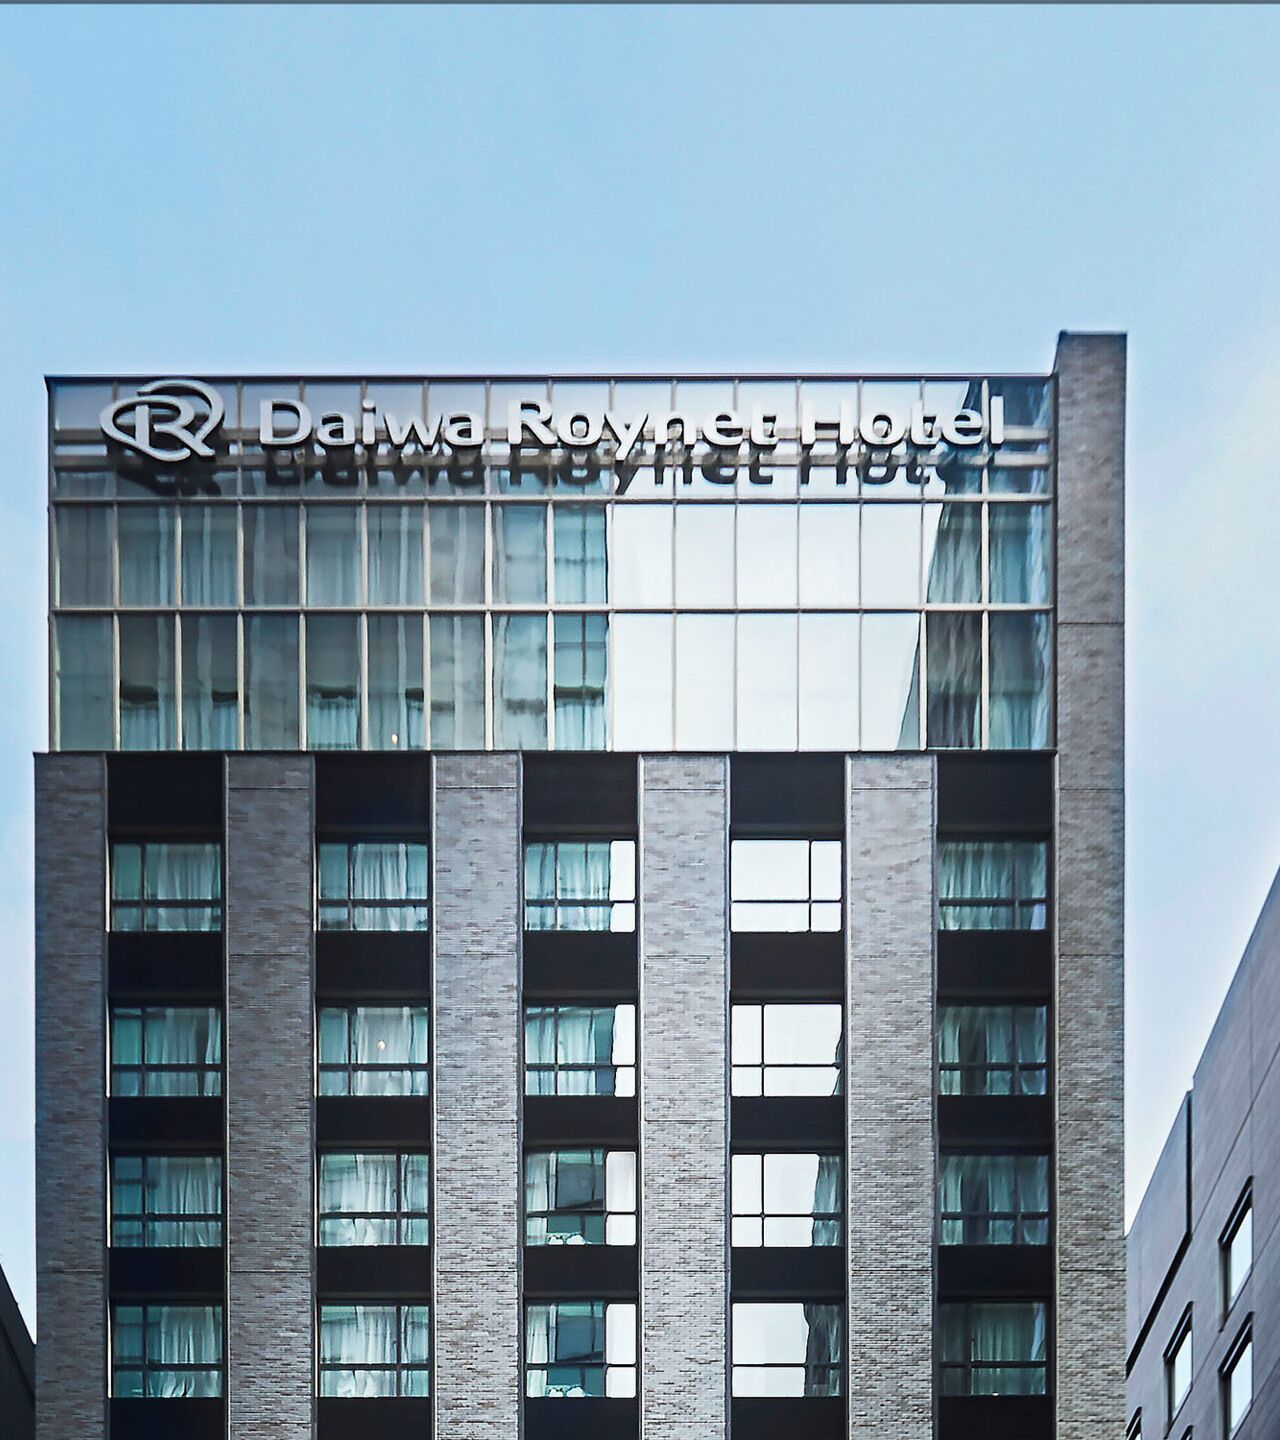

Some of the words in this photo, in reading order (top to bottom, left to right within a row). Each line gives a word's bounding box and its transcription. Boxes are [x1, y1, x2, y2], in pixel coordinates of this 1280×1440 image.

[259, 400, 482, 446] Daiwa
[507, 400, 778, 460] Roynet
[799, 396, 1005, 446] Hotel
